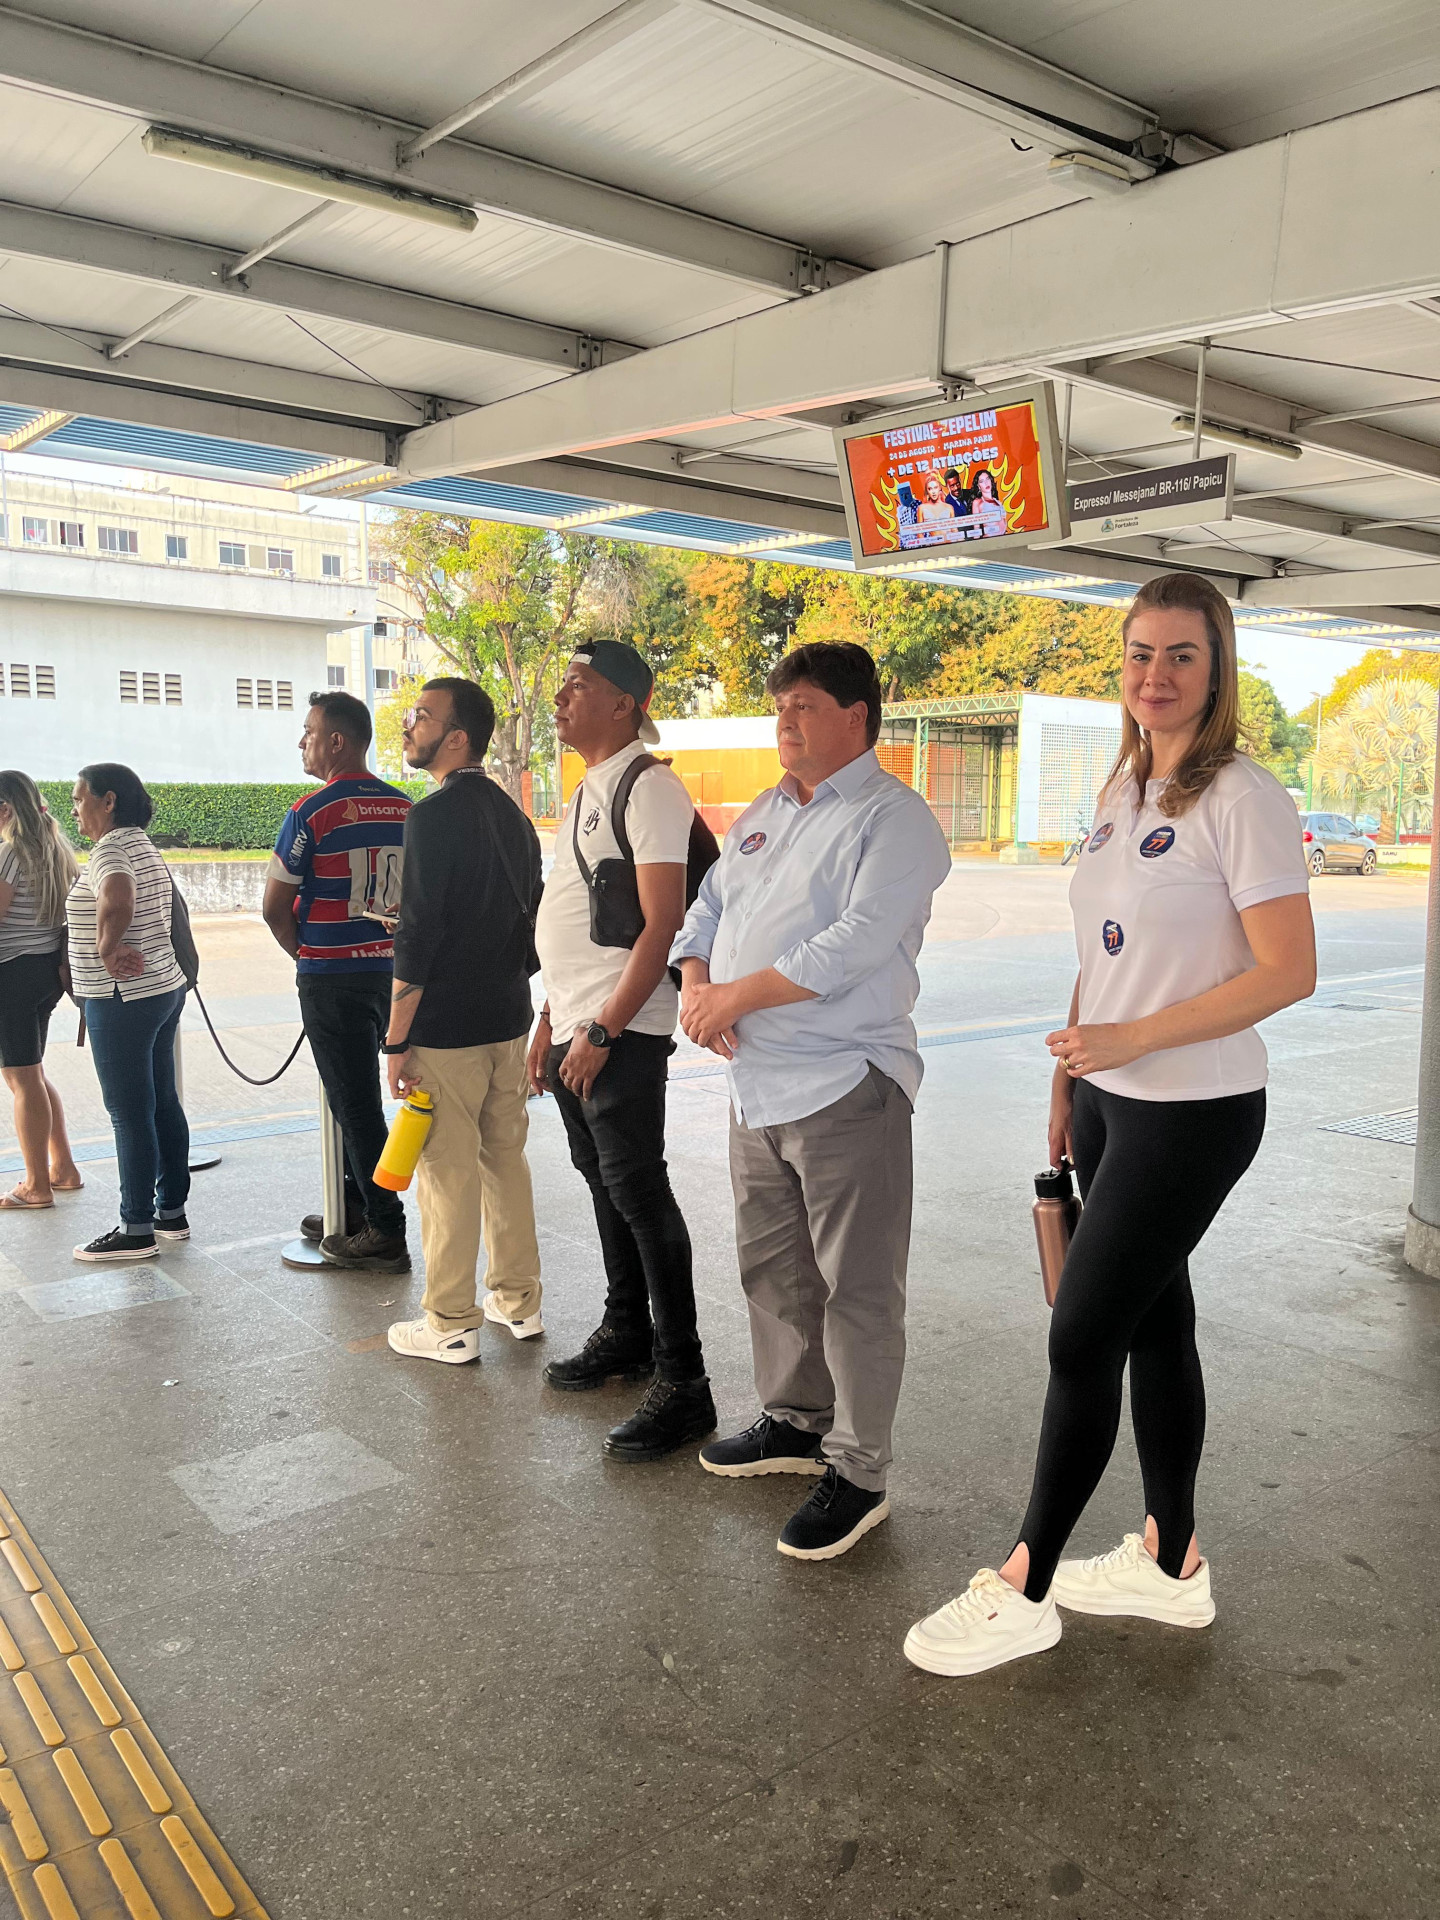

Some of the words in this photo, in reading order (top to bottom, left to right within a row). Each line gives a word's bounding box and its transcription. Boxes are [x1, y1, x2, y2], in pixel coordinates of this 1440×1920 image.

[883, 423, 938, 449] FESTIVAL
[941, 410, 997, 438] ZEPELIM
[898, 451, 907, 459] DE
[908, 445, 936, 457] AGOSTO
[943, 438, 973, 450] MARINA
[974, 434, 993, 444] PARK
[898, 462, 914, 476] DE
[915, 460, 929, 473] 12
[932, 447, 999, 469] ATRAÇÕES
[1074, 491, 1112, 512] Expresso/
[1113, 483, 1157, 504] Messejana/
[1159, 476, 1192, 496] BR-116/
[1193, 472, 1223, 491] Papicu
[1114, 521, 1139, 529] Fortaleza
[358, 803, 410, 817] brisane
[292, 829, 308, 857] MRV
[1146, 838, 1167, 850] 77
